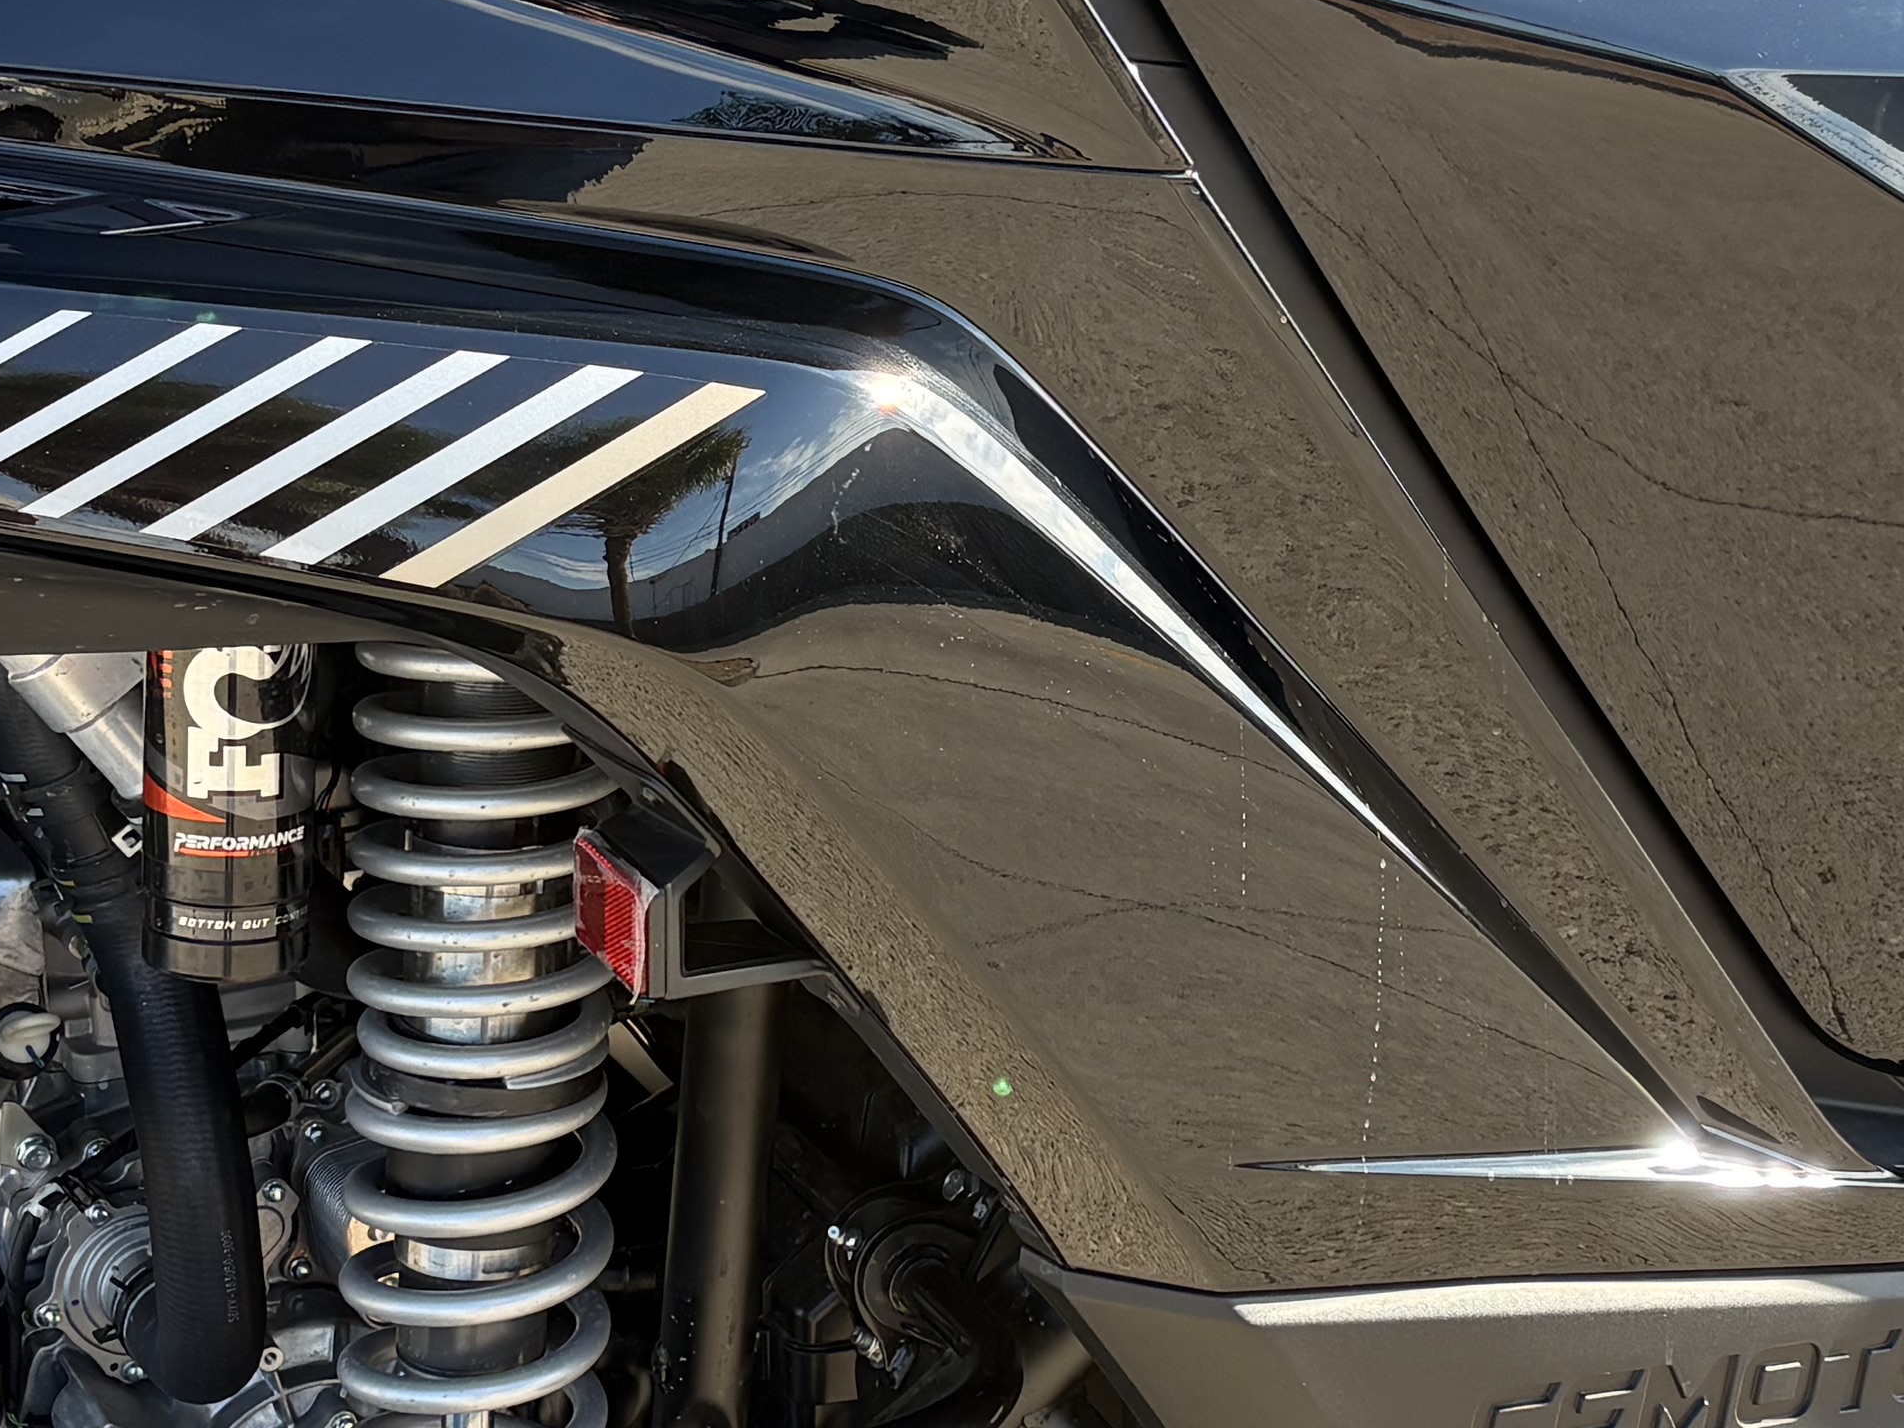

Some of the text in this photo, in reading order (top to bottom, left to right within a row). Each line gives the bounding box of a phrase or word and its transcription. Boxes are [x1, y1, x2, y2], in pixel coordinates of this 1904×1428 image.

[183, 644, 312, 800] FO
[174, 825, 305, 853] PERFORMANCE
[178, 916, 237, 930] BOTTOM
[242, 917, 270, 930] OUT
